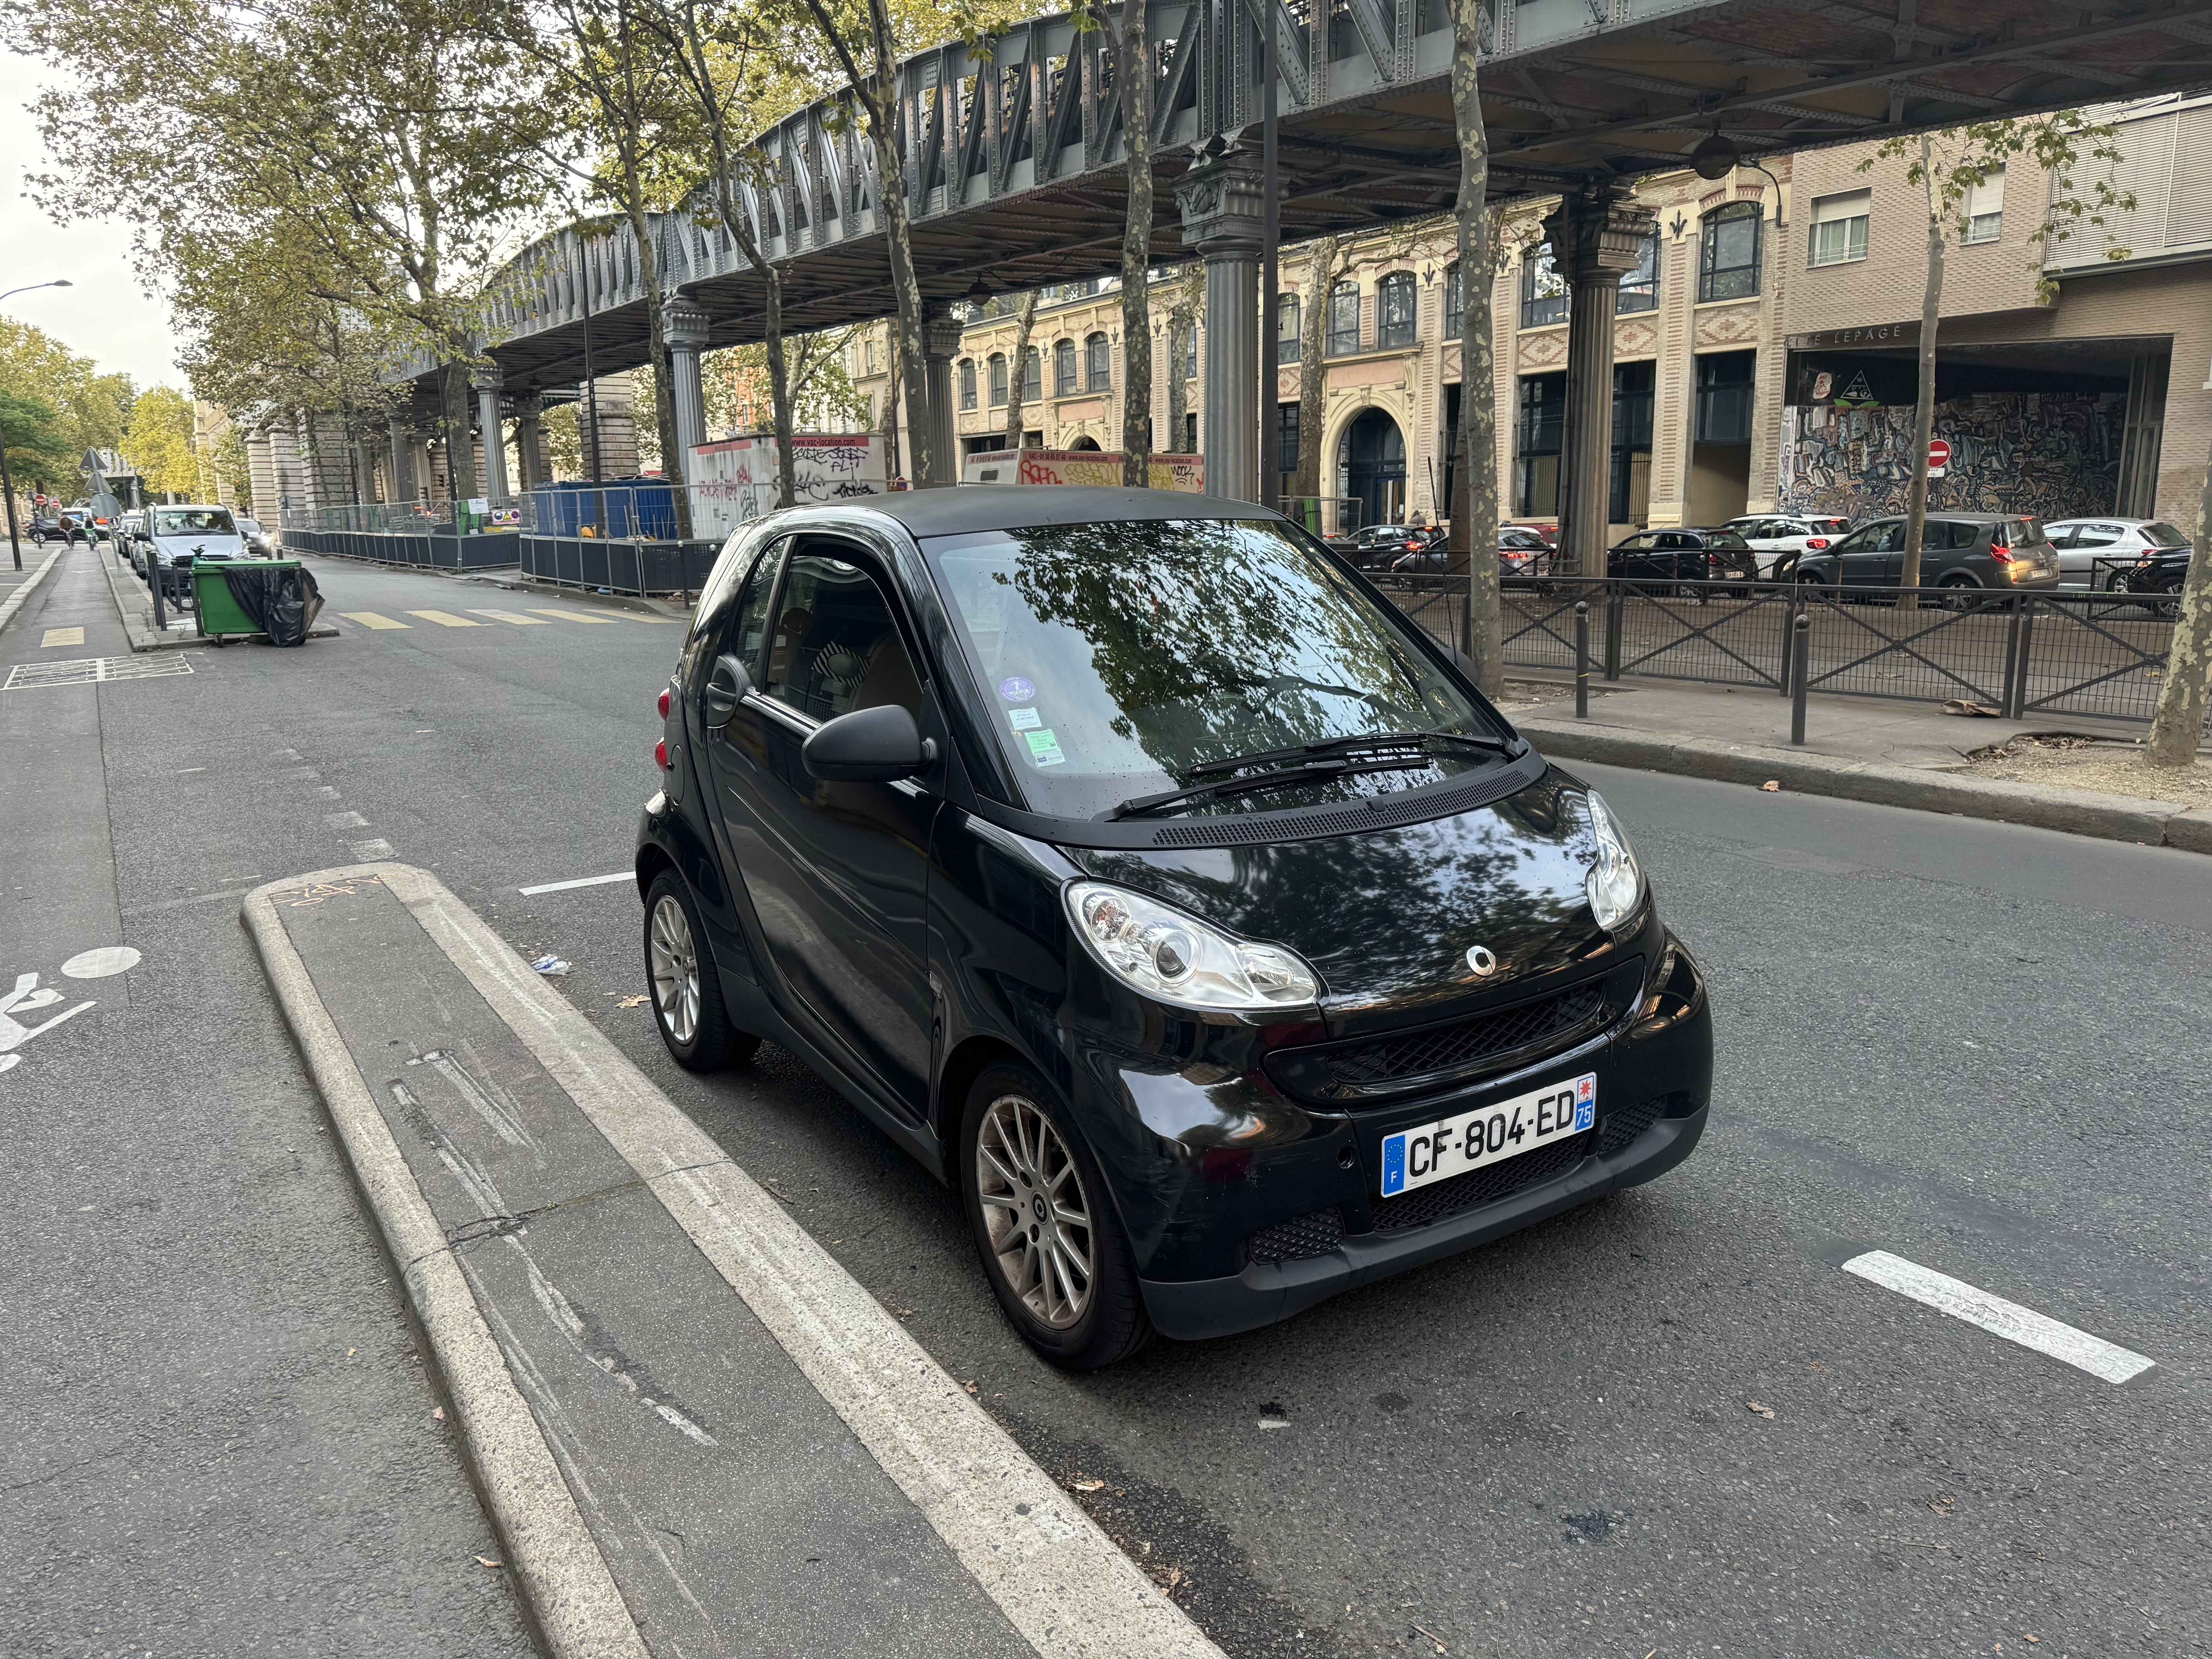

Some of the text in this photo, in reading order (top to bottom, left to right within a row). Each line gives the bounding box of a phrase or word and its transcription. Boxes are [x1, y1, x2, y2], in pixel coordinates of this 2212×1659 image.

[1835, 326, 1900, 343] LEPAGE
[791, 438, 855, 446] www.vac-location.com
[1577, 1105, 1592, 1127] 75
[1409, 1090, 1575, 1177] CF-804-ED
[1391, 1171, 1397, 1183] F
